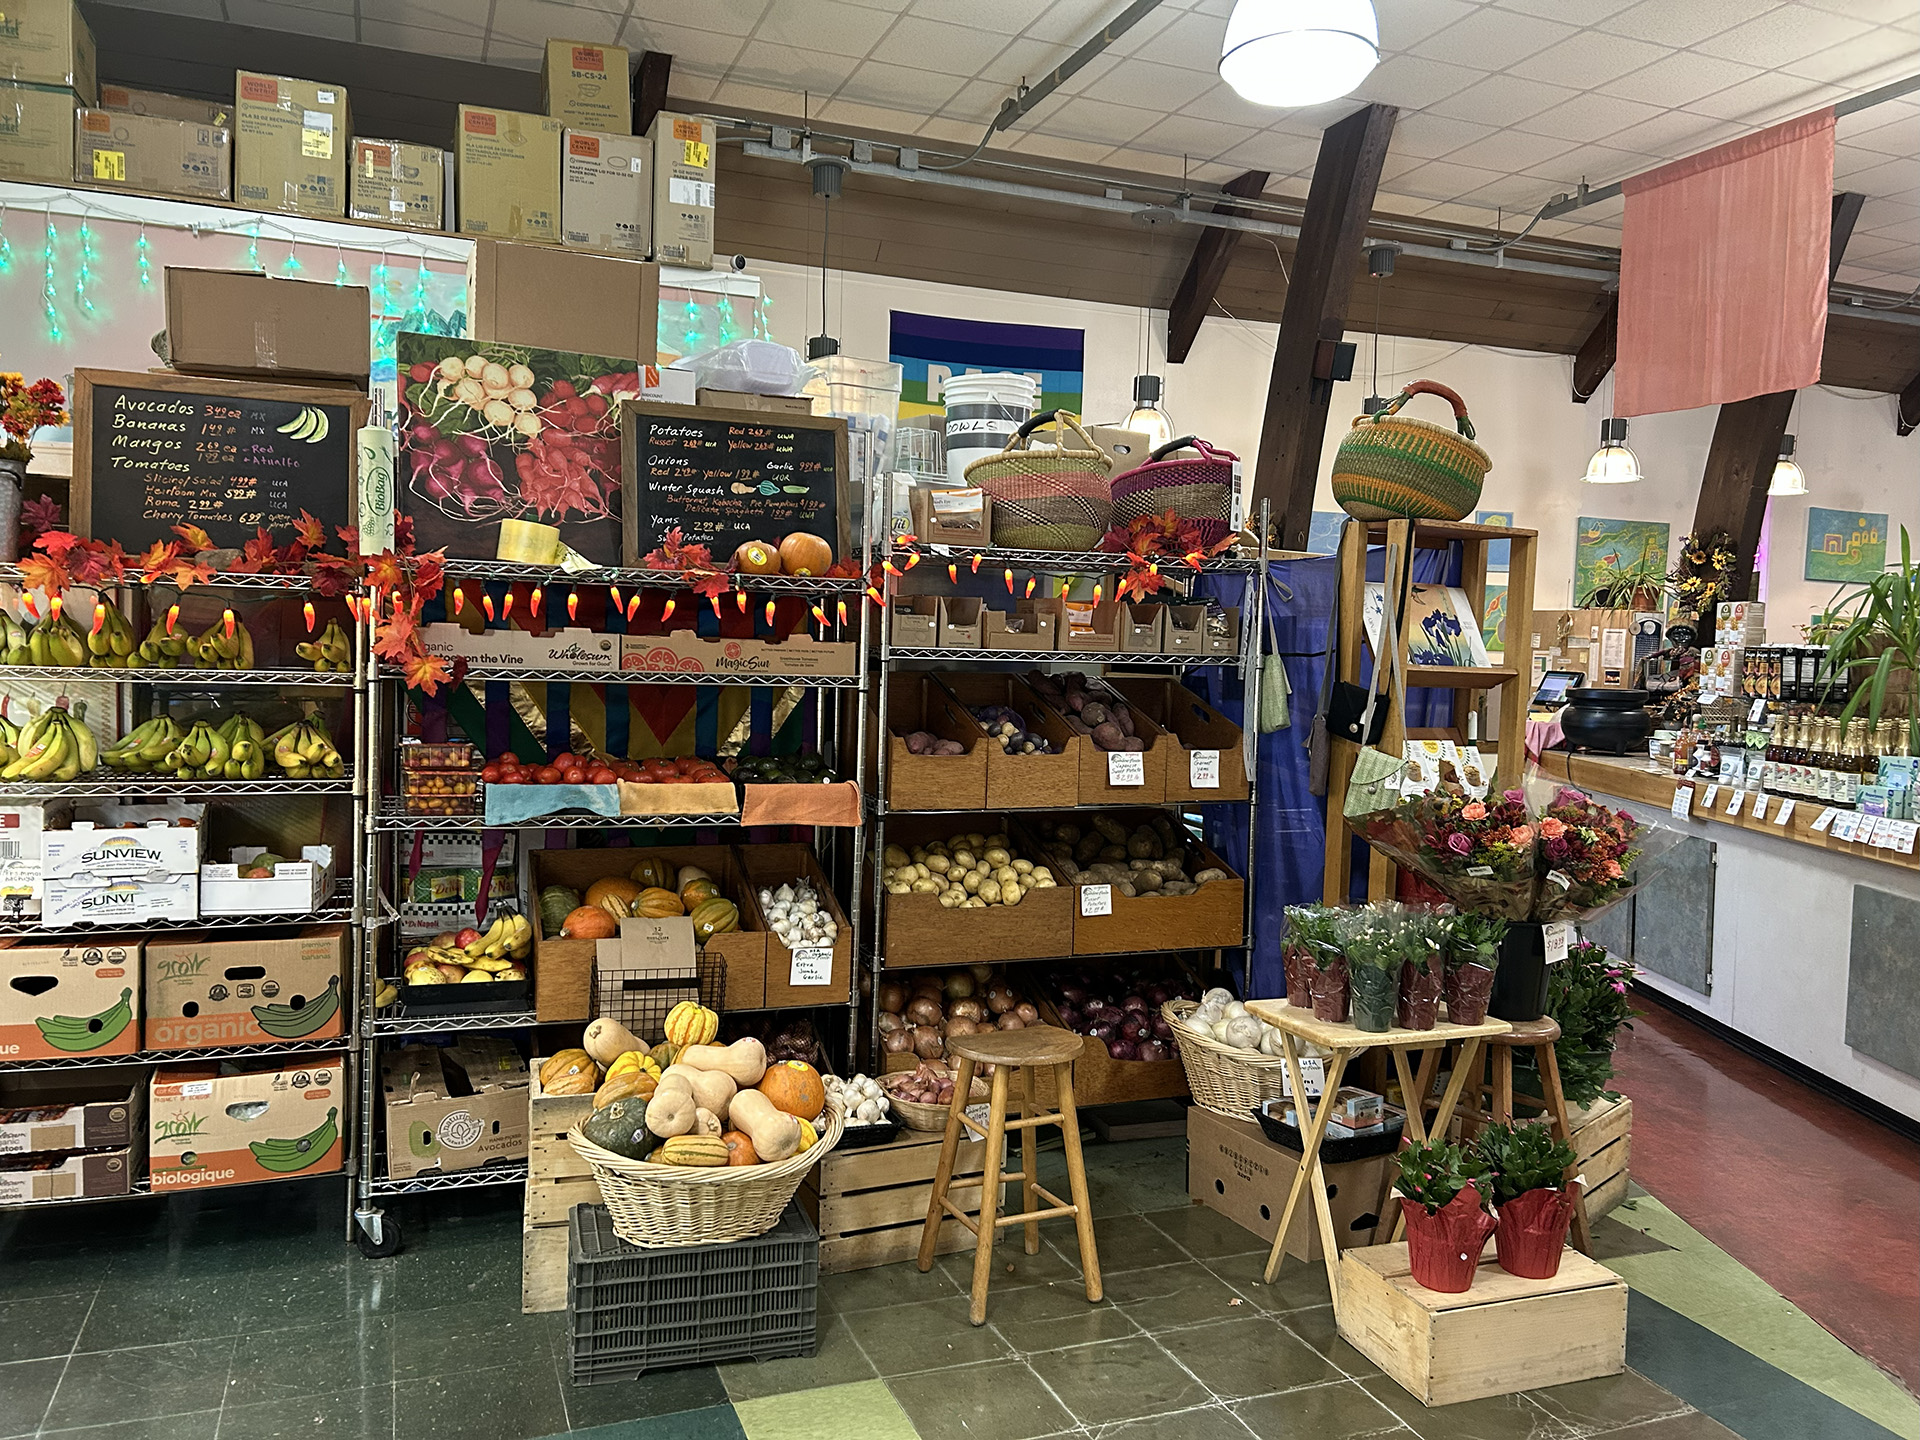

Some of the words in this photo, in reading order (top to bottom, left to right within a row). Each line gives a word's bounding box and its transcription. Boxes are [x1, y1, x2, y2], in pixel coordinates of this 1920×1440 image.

[571, 71, 608, 80] SB-CS-24
[243, 86, 276, 94] CENTRIC
[269, 116, 304, 127] RECTANGULA
[572, 144, 598, 152] CENTRIC
[114, 394, 194, 415] Avocados
[112, 413, 187, 432] Bananas
[250, 426, 265, 435] MX
[649, 424, 703, 438] Potatoes
[728, 426, 745, 436] Red
[111, 434, 182, 455] Mangos
[195, 441, 221, 453] 269
[223, 445, 238, 453] ea
[251, 444, 274, 453] Red
[648, 436, 677, 447] Russet
[727, 439, 753, 453] Yellow
[111, 456, 190, 473] Tomatoes
[647, 454, 689, 466] Onions
[766, 462, 795, 471] Garlic
[649, 467, 671, 476] Red
[191, 476, 225, 486] Salad
[144, 485, 196, 497] Heirloom
[199, 488, 217, 498] Mix
[375, 472, 387, 511] BioBag
[648, 482, 683, 492] Winter
[685, 484, 724, 497] Squash
[144, 495, 181, 508] Roma
[142, 509, 185, 526] Cherry
[187, 510, 233, 522] Tomatoes
[650, 514, 680, 528] Yams
[733, 522, 751, 531] UCA
[892, 518, 907, 534] fit
[422, 640, 454, 653] ganic
[464, 655, 478, 664] on
[479, 654, 497, 664] the
[498, 654, 524, 665] Vine
[548, 649, 612, 661] Wholesum
[572, 659, 590, 667] Grown
[716, 656, 770, 669] MagicSun
[81, 848, 161, 863] SUNVIEW
[81, 893, 134, 909] SUNVI
[155, 1017, 261, 1045] organic
[477, 1139, 523, 1153] Avocados
[151, 1167, 236, 1185] biologique
